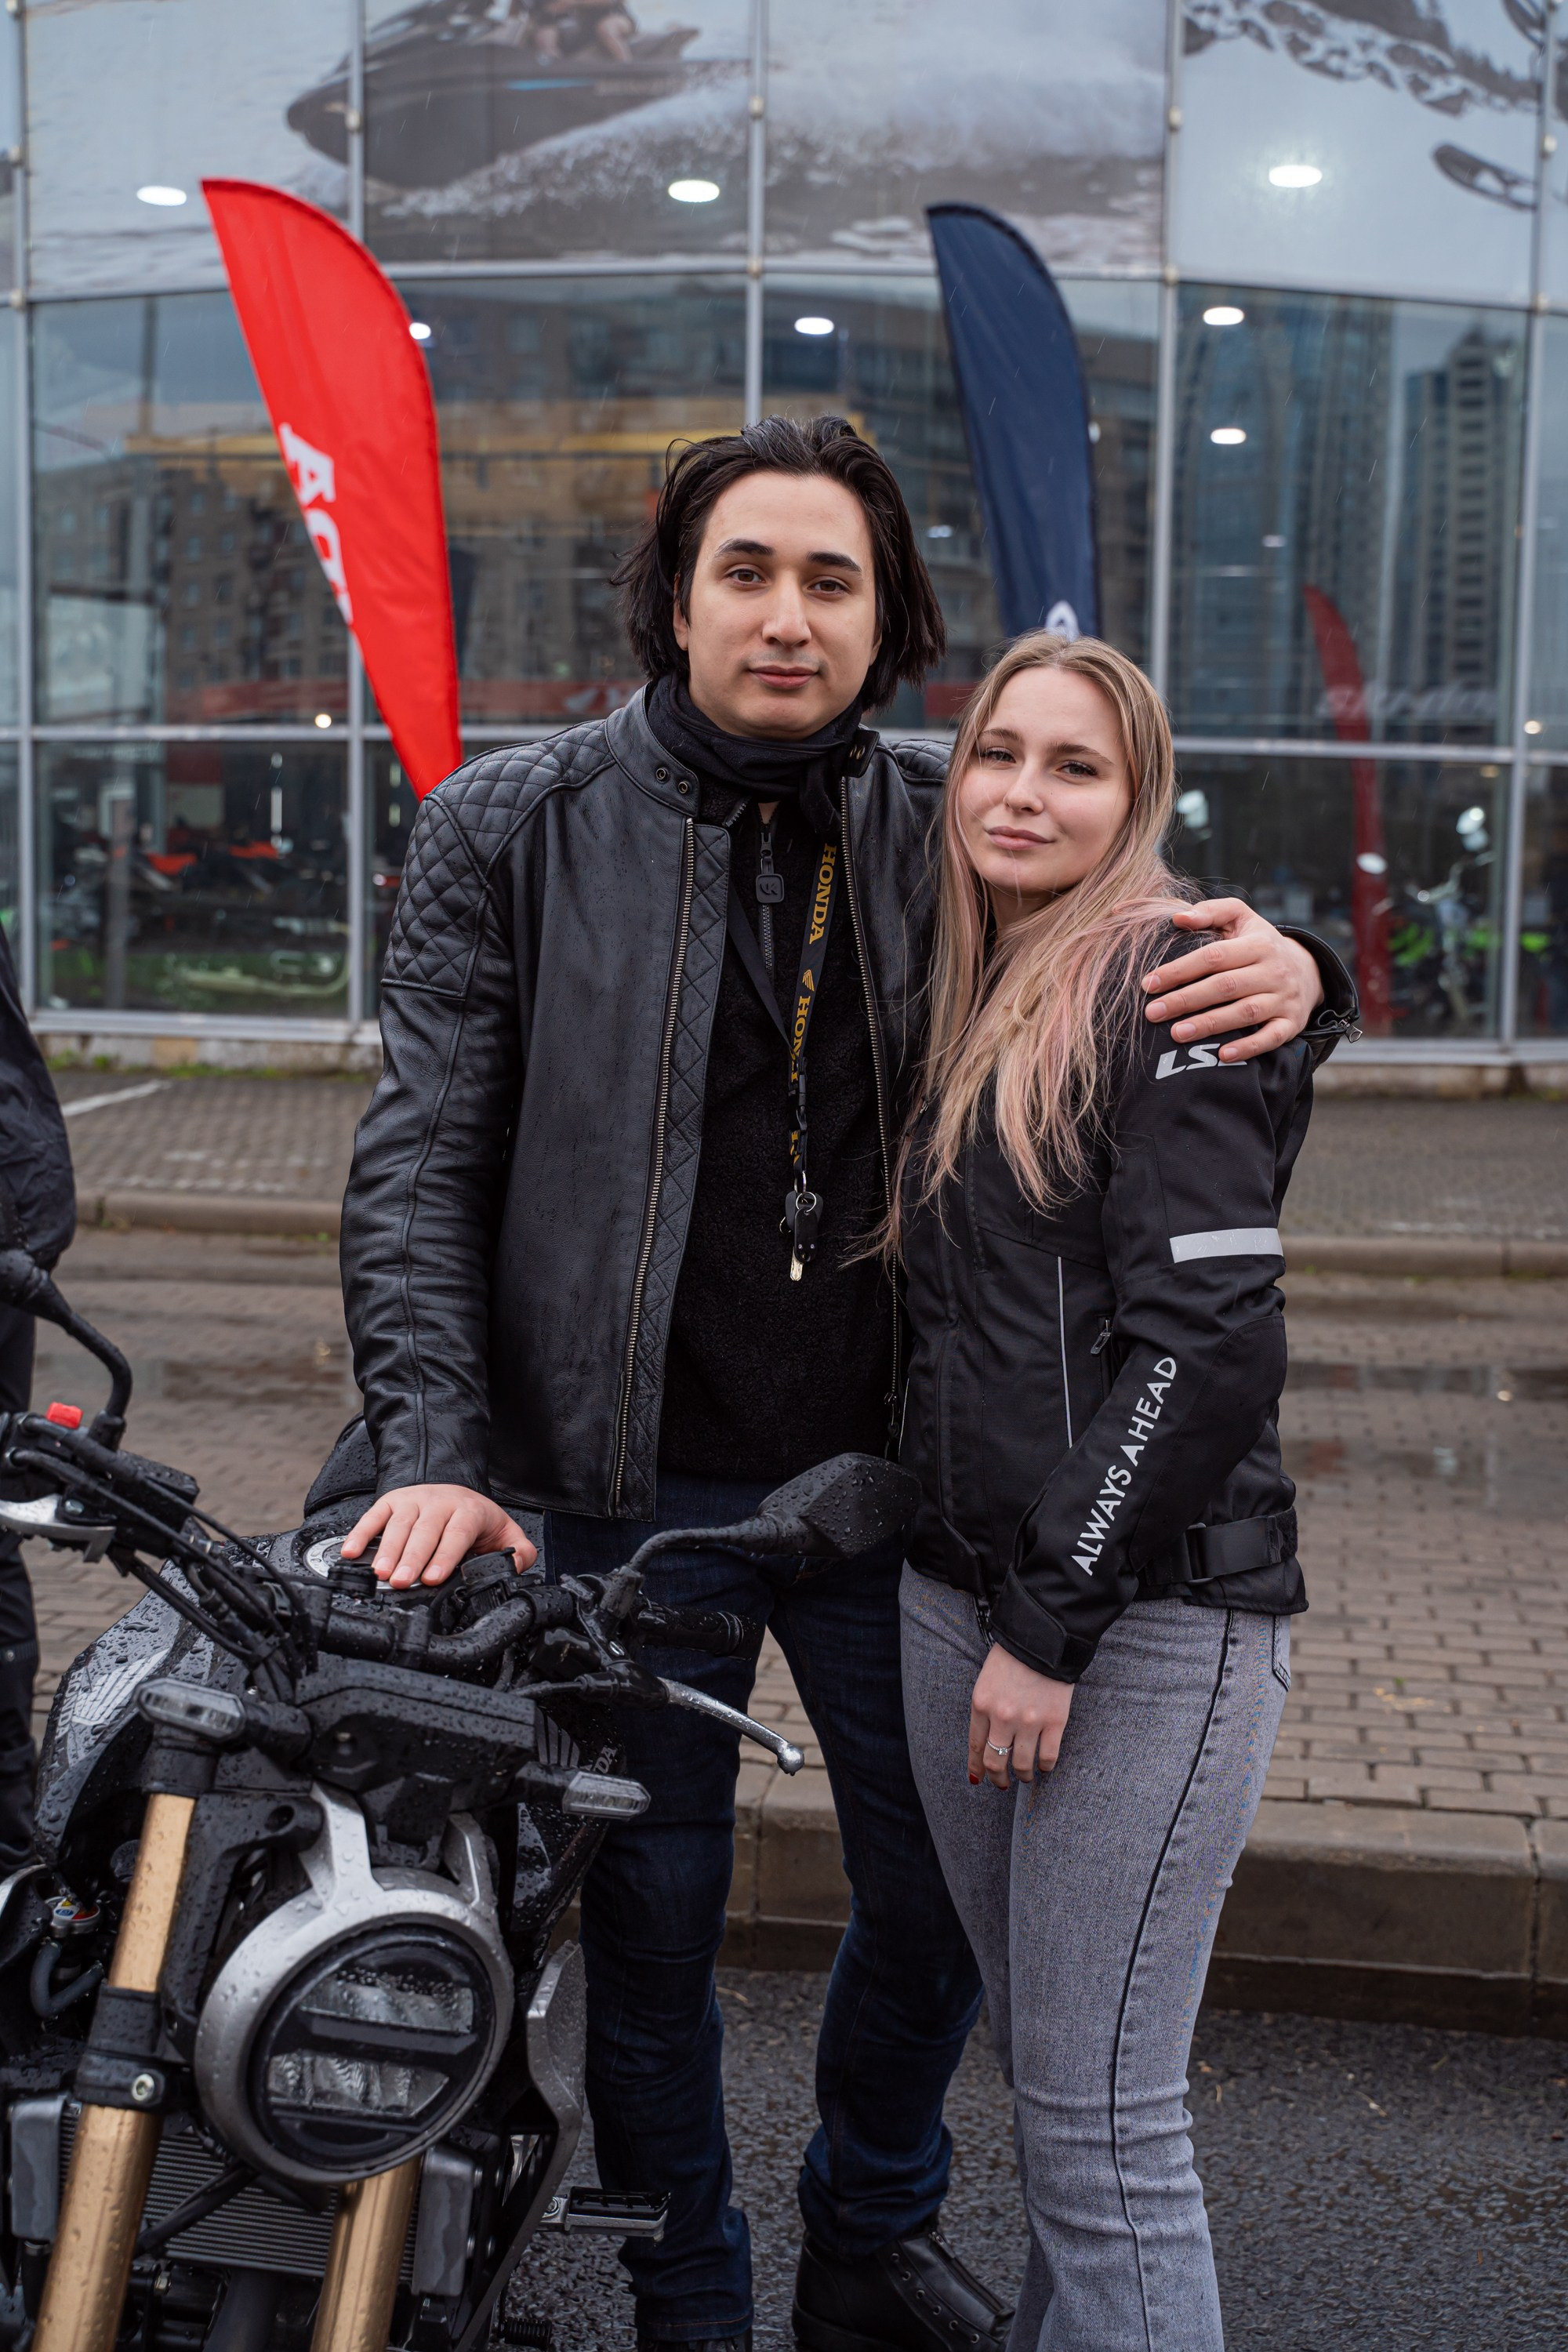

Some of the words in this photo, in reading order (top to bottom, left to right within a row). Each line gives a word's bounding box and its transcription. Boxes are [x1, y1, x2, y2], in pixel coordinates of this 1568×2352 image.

[809, 843, 837, 945] HONDA
[1156, 1044, 1248, 1080] LS
[1071, 1465, 1131, 1576] ALWAYS
[1120, 1357, 1177, 1467] AHEAD
[54, 1666, 85, 1740] HONDA
